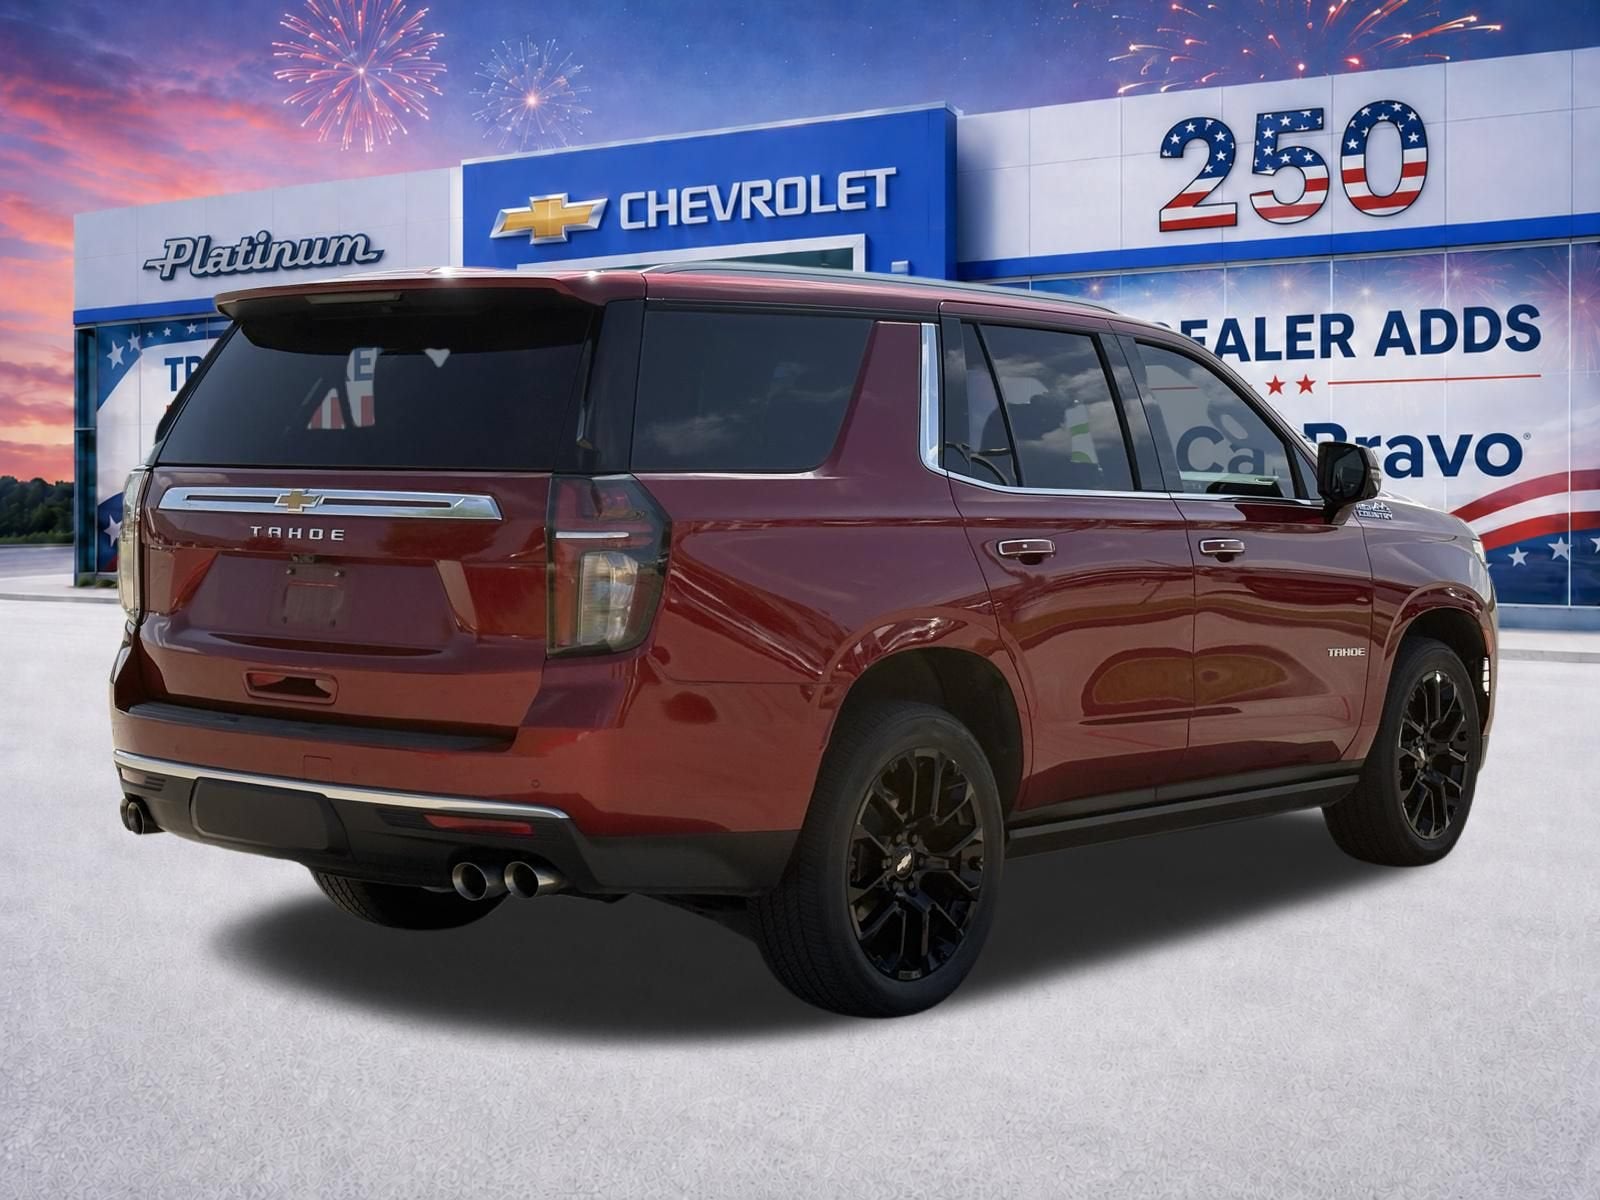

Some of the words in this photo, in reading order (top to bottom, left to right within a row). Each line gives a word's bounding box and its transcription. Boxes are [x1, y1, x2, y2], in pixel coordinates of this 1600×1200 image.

[1159, 100, 1428, 232] 250
[620, 167, 896, 230] CHEVROLET
[143, 230, 384, 280] Platinum
[1180, 313, 1356, 362] EALER
[1374, 304, 1541, 357] ADDS
[250, 526, 345, 541] TAHOE
[1327, 647, 1366, 657] TAHOE
